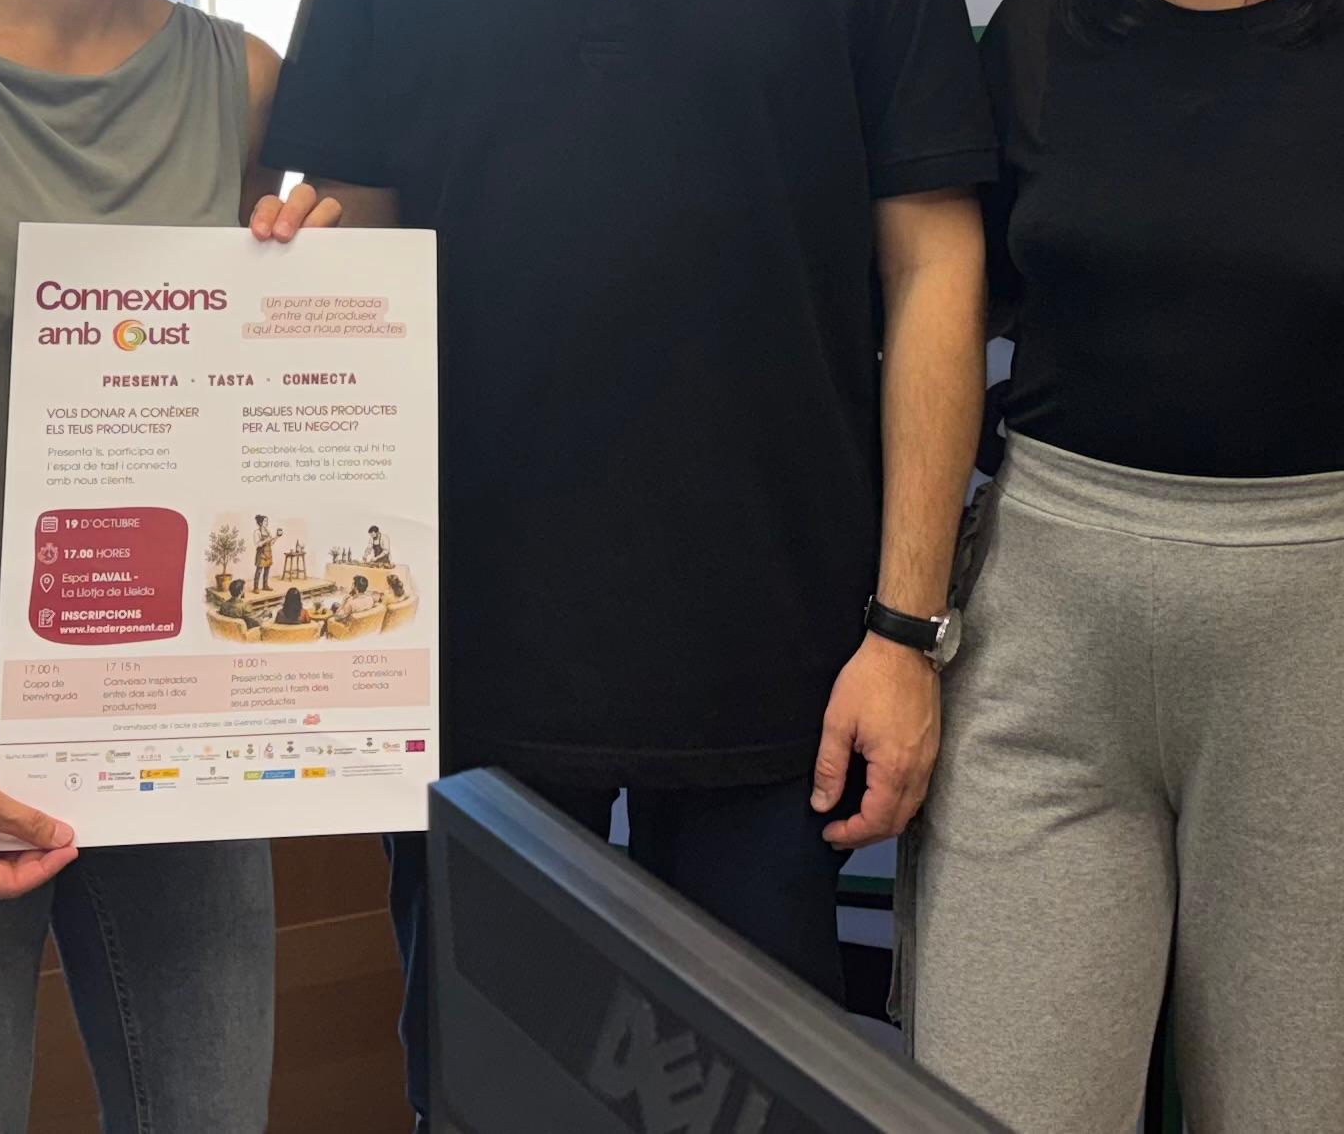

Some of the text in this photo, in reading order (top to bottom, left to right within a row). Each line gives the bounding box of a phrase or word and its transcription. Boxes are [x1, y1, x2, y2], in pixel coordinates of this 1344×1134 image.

[36, 281, 227, 311] Connexions
[266, 298, 382, 310] Un punt de trobada
[271, 311, 377, 323] entre qui produeix
[38, 322, 101, 345] amb
[247, 323, 403, 336] i qui busca nous productes
[103, 373, 356, 387] PRESENTA TASTA CONNECTA
[47, 408, 78, 418] VOLS
[81, 408, 125, 418] DONAR
[128, 408, 138, 418] A
[242, 405, 397, 417] BUSQUES NOUS PRODUCTES
[46, 424, 172, 434] ELS TEUS PRODUCTES?
[242, 421, 359, 433] PER AL TEU NEGOCI?
[108, 448, 154, 460] participa
[354, 444, 368, 455] qui
[371, 444, 380, 452] hi
[383, 444, 395, 452] ha
[100, 462, 118, 470] tast
[126, 461, 177, 470] connecta
[337, 459, 360, 467] crea
[363, 458, 392, 466] noves
[46, 476, 71, 486] amb
[101, 475, 135, 484] clients.
[241, 474, 301, 484] oportunitats
[65, 518, 140, 528] 19 D'OCTUBRE
[64, 549, 131, 558] 17.00 HORES
[62, 574, 89, 584] Espai
[92, 573, 132, 582] DAVALL
[62, 586, 155, 599] La Llotja de Lleida
[61, 610, 142, 621] INSCRIPCIONS
[60, 623, 175, 635] www.leaderponent.cat
[284, 672, 296, 681] de
[51, 680, 64, 688] de
